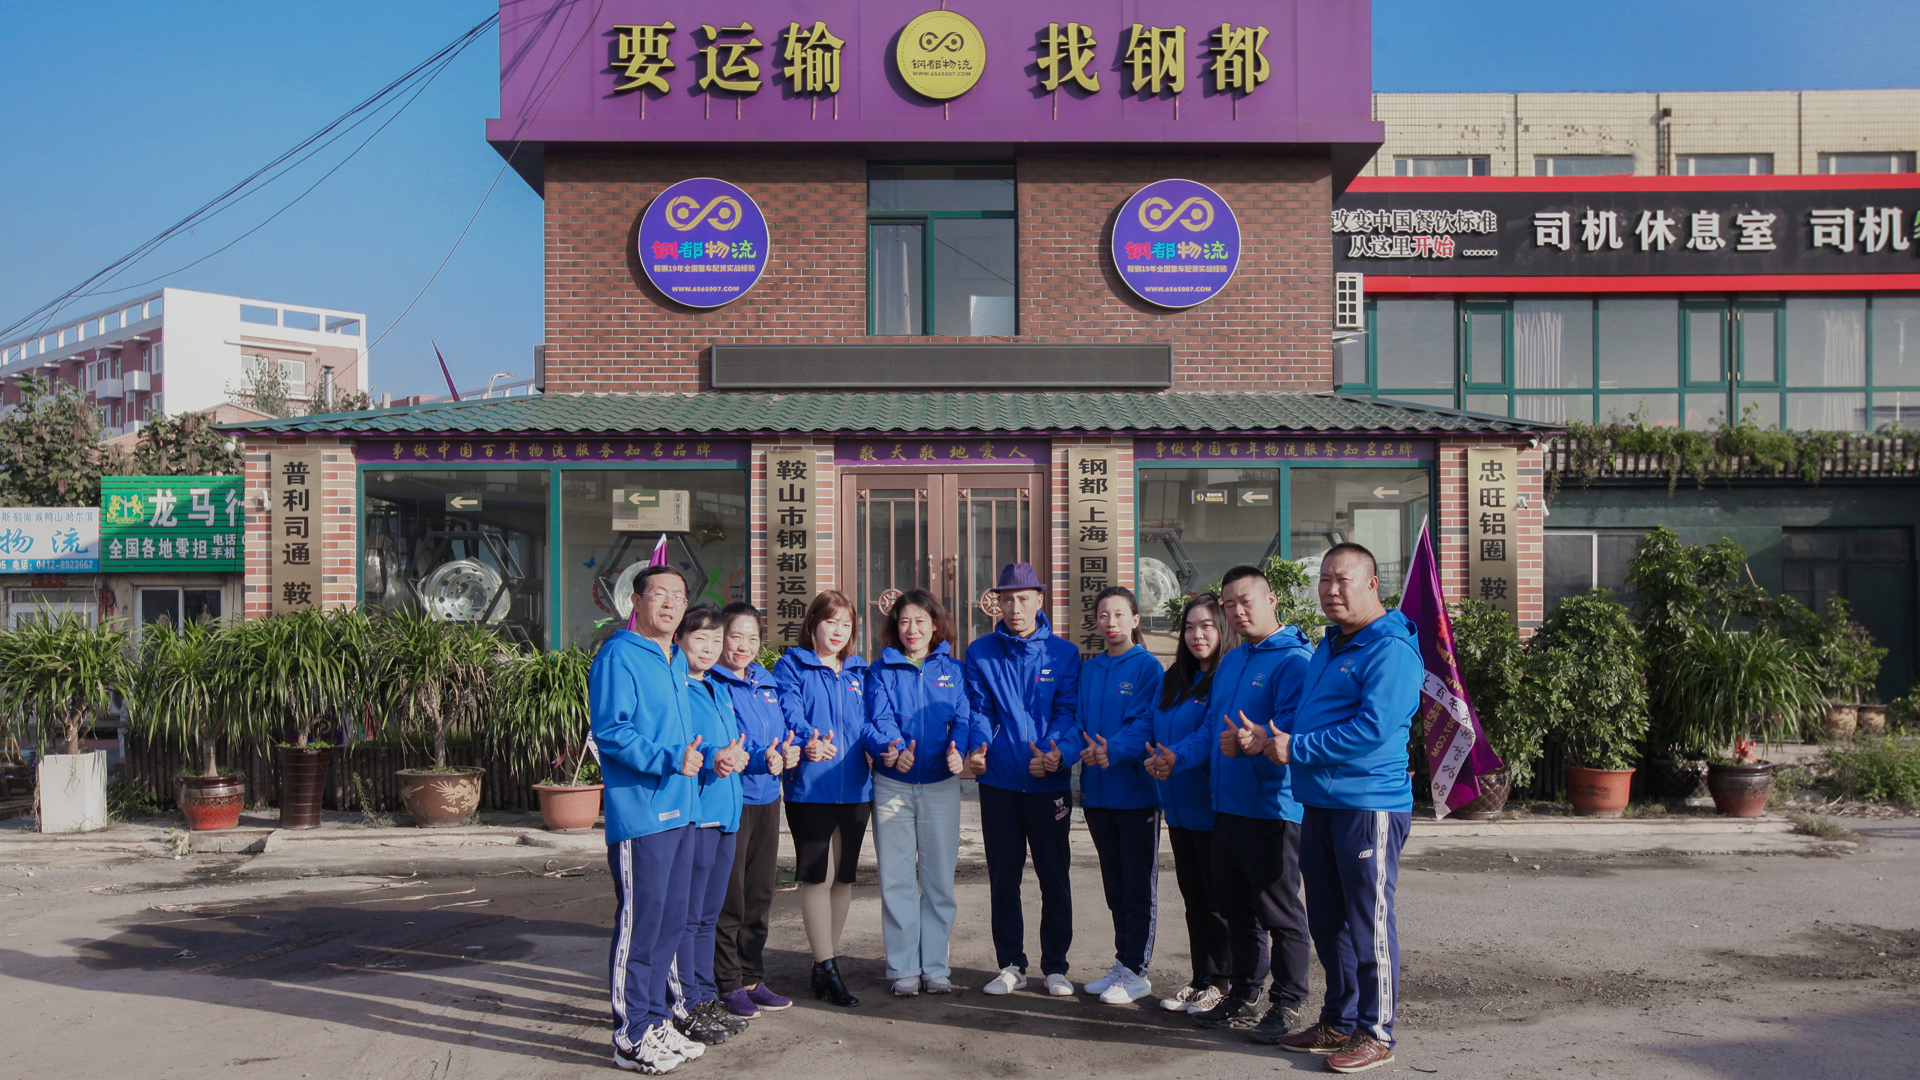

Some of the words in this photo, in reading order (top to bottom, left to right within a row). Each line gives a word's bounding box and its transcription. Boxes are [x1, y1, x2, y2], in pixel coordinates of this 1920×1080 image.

[612, 20, 845, 95] 要运输
[911, 59, 973, 70] 钢都物流
[1038, 21, 1271, 95] 找钢都
[1332, 208, 1498, 234] 改变中国餐饮标准
[1532, 208, 1778, 253] 司机休息室
[1810, 206, 1920, 253] 司机
[651, 239, 757, 259] 钢都物流
[1124, 240, 1229, 260] 钢都物流
[1348, 235, 1455, 258] 从这里开始
[392, 441, 712, 460] 争做中国百年物流服务知名品牌
[1155, 441, 1413, 459] 争做中国百年物流服务知名品牌
[282, 461, 311, 566] 普利司通
[1478, 459, 1507, 562] 忠旺铝圈
[0, 527, 89, 555] 物流
[109, 537, 208, 559] 全国各地零担
[212, 533, 237, 546] 电话
[210, 547, 236, 559] 手机
[776, 459, 808, 655] 鞍山市钢都运输有
[36, 560, 93, 570] 0412-8923662
